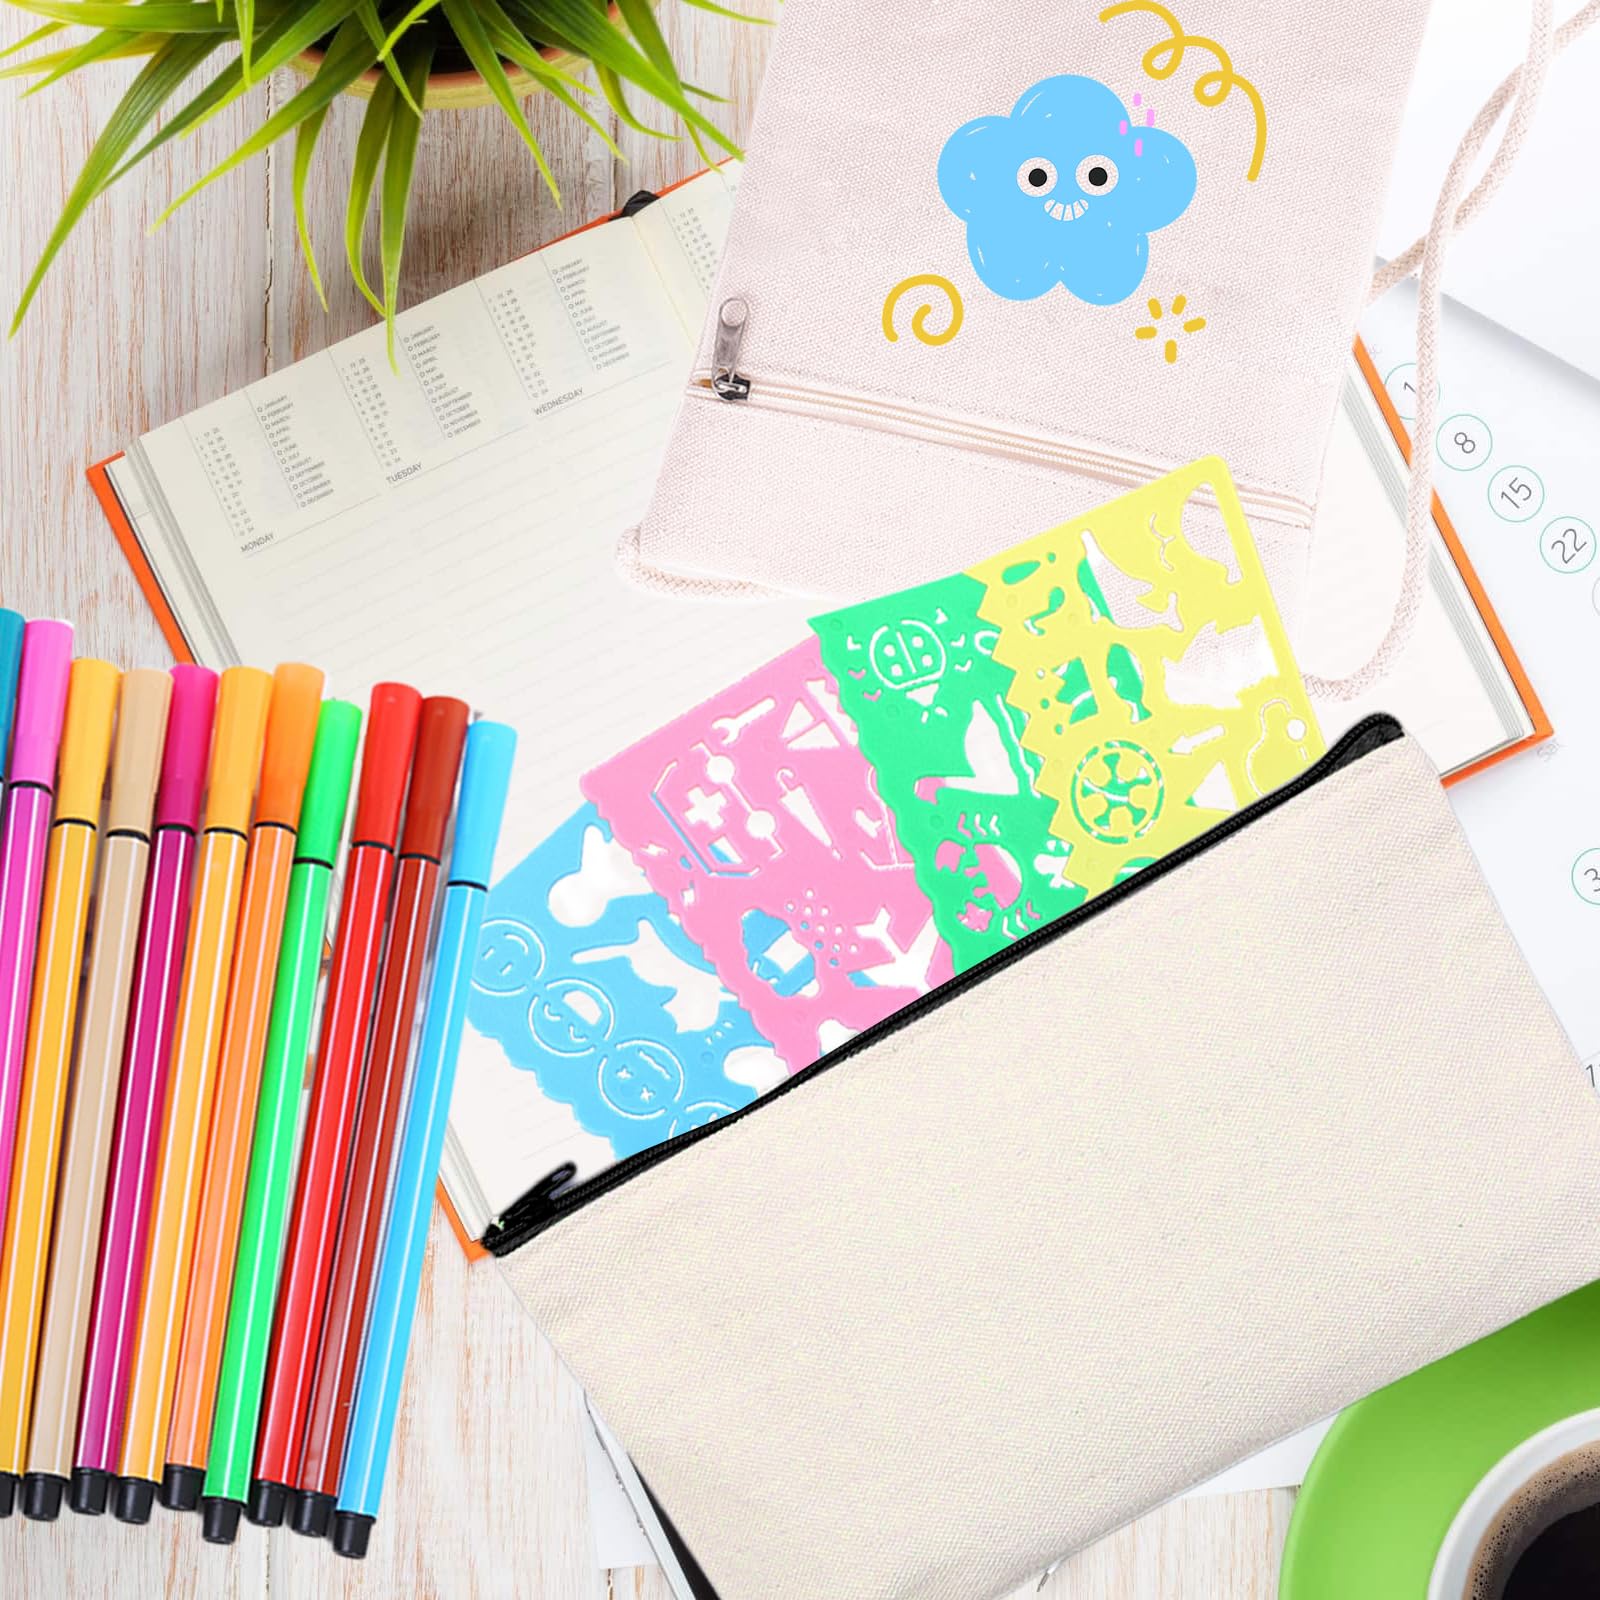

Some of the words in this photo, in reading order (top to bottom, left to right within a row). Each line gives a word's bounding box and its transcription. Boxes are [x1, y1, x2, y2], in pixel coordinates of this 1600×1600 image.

[534, 387, 584, 416] WEDNESDAY
[1453, 431, 1476, 455] 8
[386, 462, 423, 484] TUESDAY
[1500, 476, 1533, 510] 15
[240, 532, 274, 552] MONDAY
[1550, 527, 1588, 565] 22
